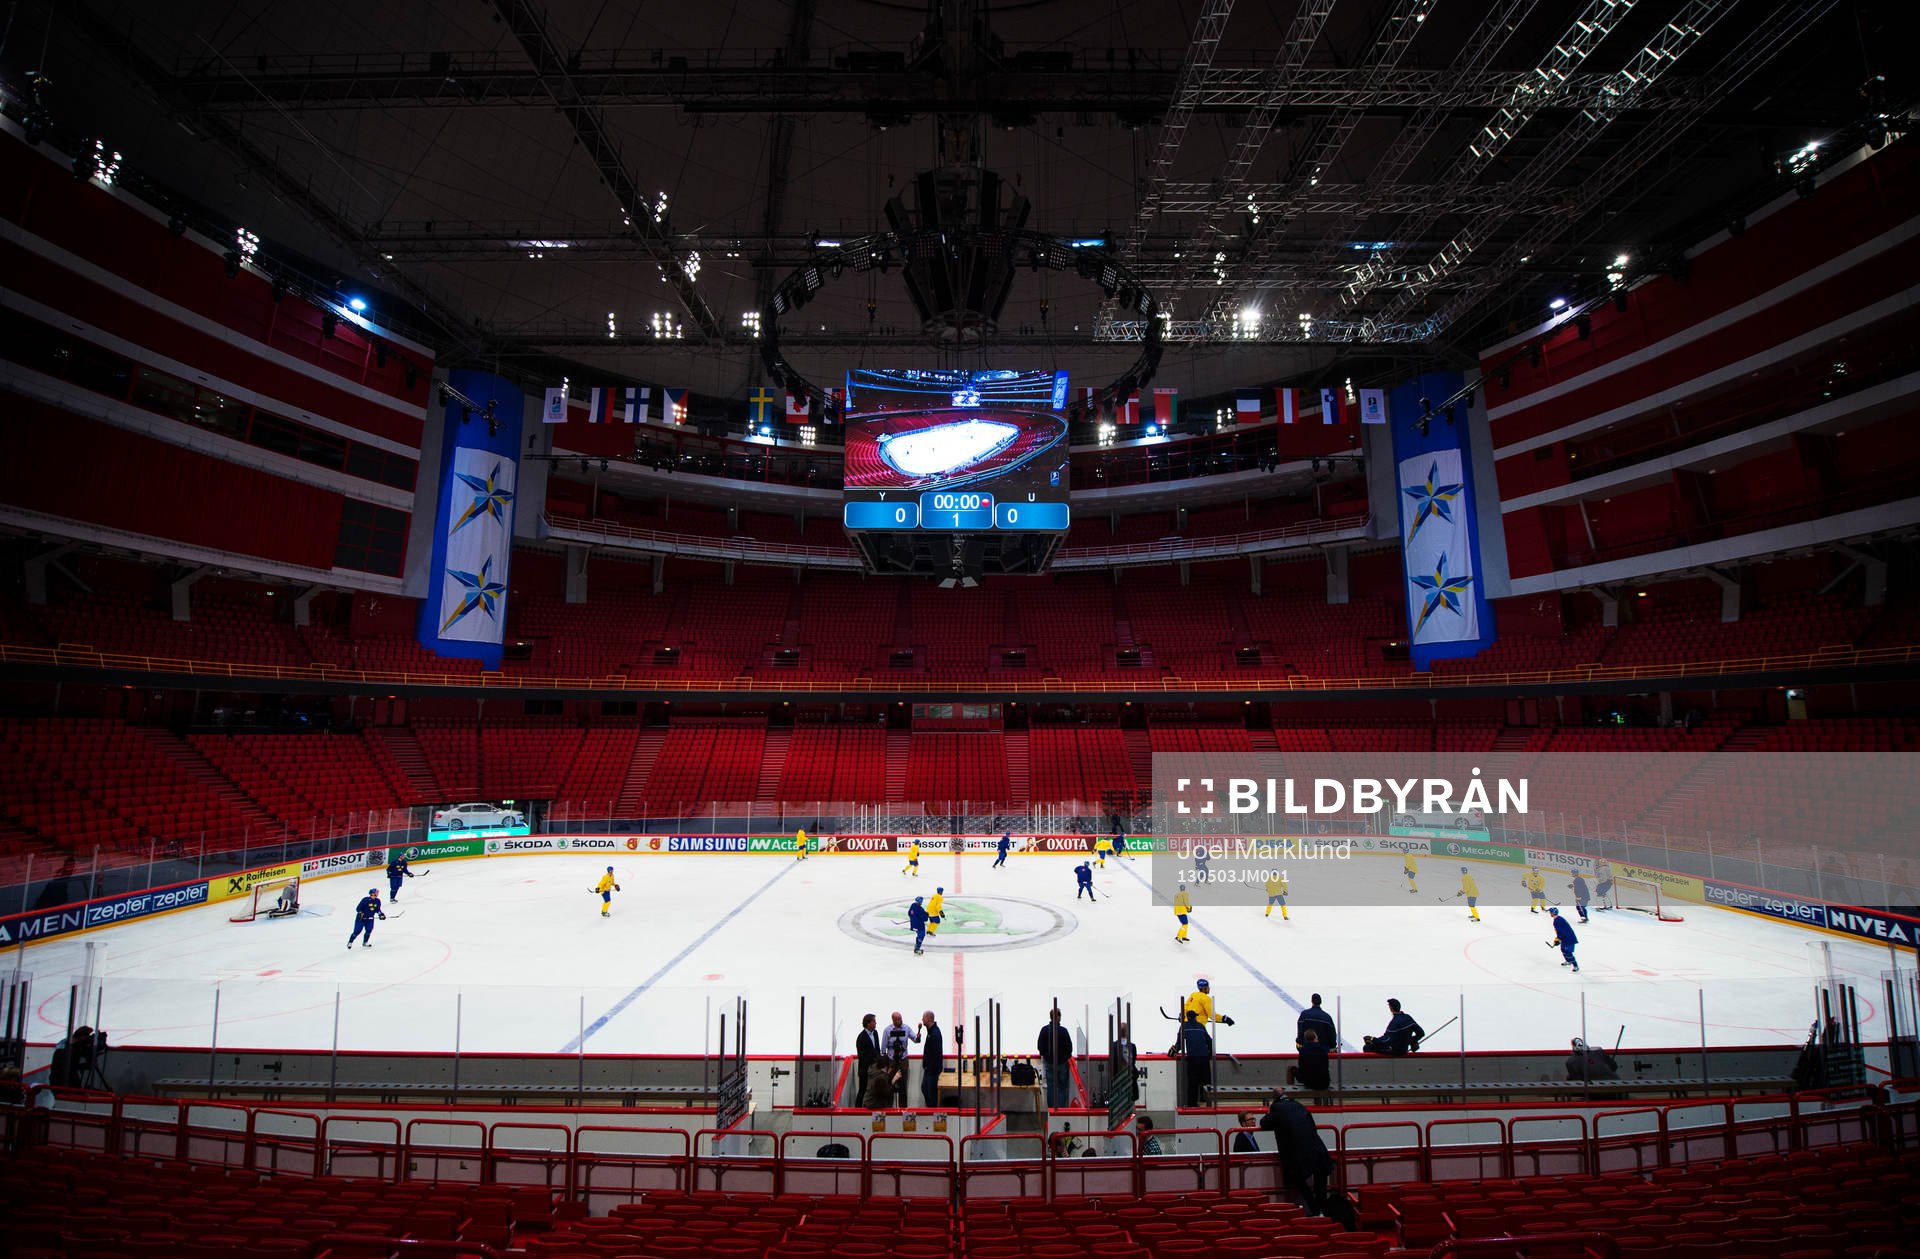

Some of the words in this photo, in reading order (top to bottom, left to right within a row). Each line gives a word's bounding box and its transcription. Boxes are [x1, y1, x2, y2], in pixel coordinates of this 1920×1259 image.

[879, 492, 886, 501] Y
[934, 494, 980, 509] 00:00
[1028, 493, 1036, 501] U
[895, 508, 906, 523] 0
[952, 513, 959, 527] 1
[1007, 509, 1018, 523] 0
[504, 839, 552, 849] ŠKODA
[572, 838, 615, 848] ŠKODA
[670, 837, 747, 850] SAMSUNG
[772, 839, 817, 850] Actais
[1170, 838, 1247, 850] BAUHAUS
[1379, 840, 1430, 851] ŠKODA
[320, 853, 365, 868] TISSOT
[1546, 852, 1592, 867] TISSOT
[246, 868, 286, 881] Raiffeisen
[1637, 868, 1690, 886] Райффайзен
[89, 897, 151, 920] zepter
[154, 885, 208, 906] zepter
[1705, 885, 1758, 905] zepter
[1761, 897, 1823, 919] zepter
[18, 910, 80, 938] MEN
[1830, 909, 1910, 942] NIVEA
